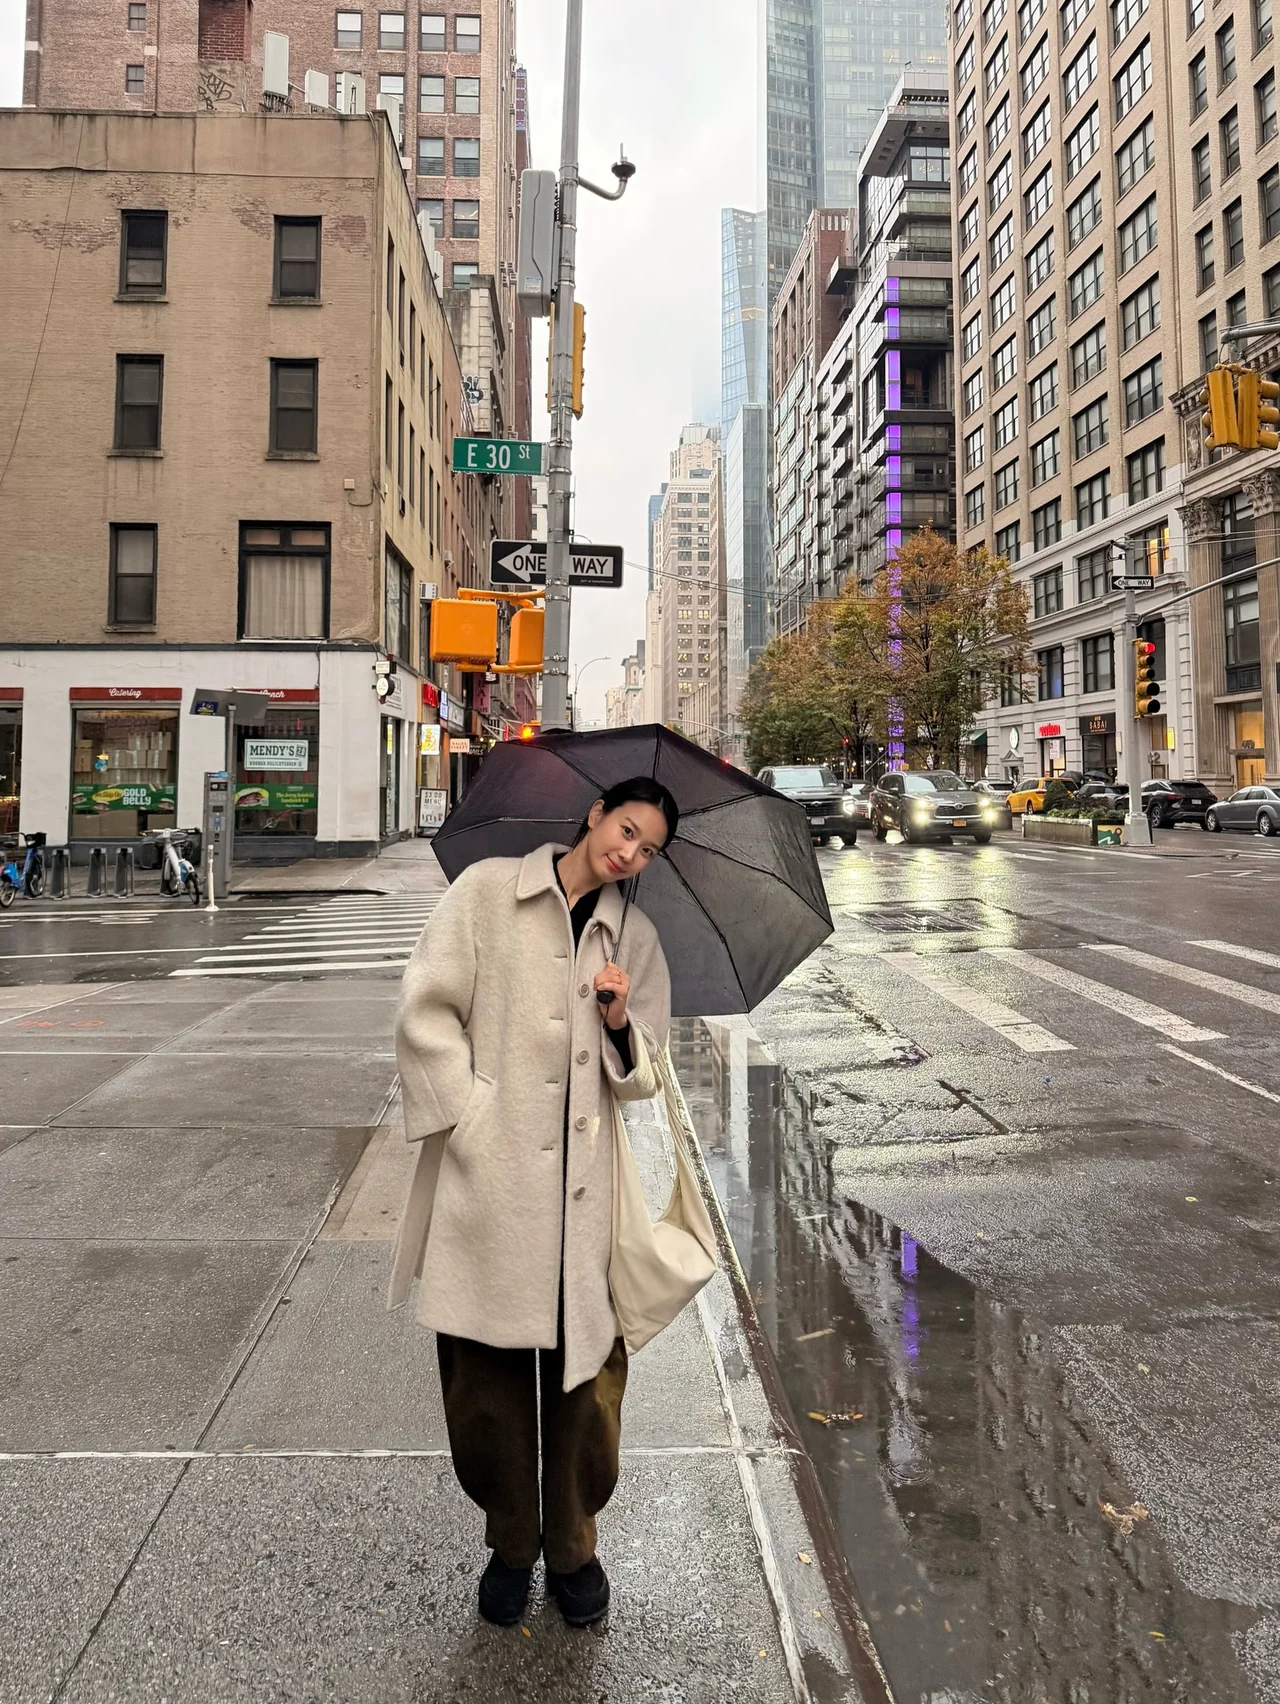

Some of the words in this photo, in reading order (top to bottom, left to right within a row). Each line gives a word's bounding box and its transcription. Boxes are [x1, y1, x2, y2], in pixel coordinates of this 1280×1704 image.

[467, 443, 478, 467] E
[486, 444, 511, 469] 30
[519, 445, 530, 459] St
[513, 554, 546, 571] ONE
[573, 557, 608, 575] WAY
[1117, 579, 1129, 587] ONE
[109, 688, 142, 699] Catering
[1038, 723, 1061, 737] verizon
[249, 745, 295, 757] MENDY'S
[123, 788, 147, 797] GOLD
